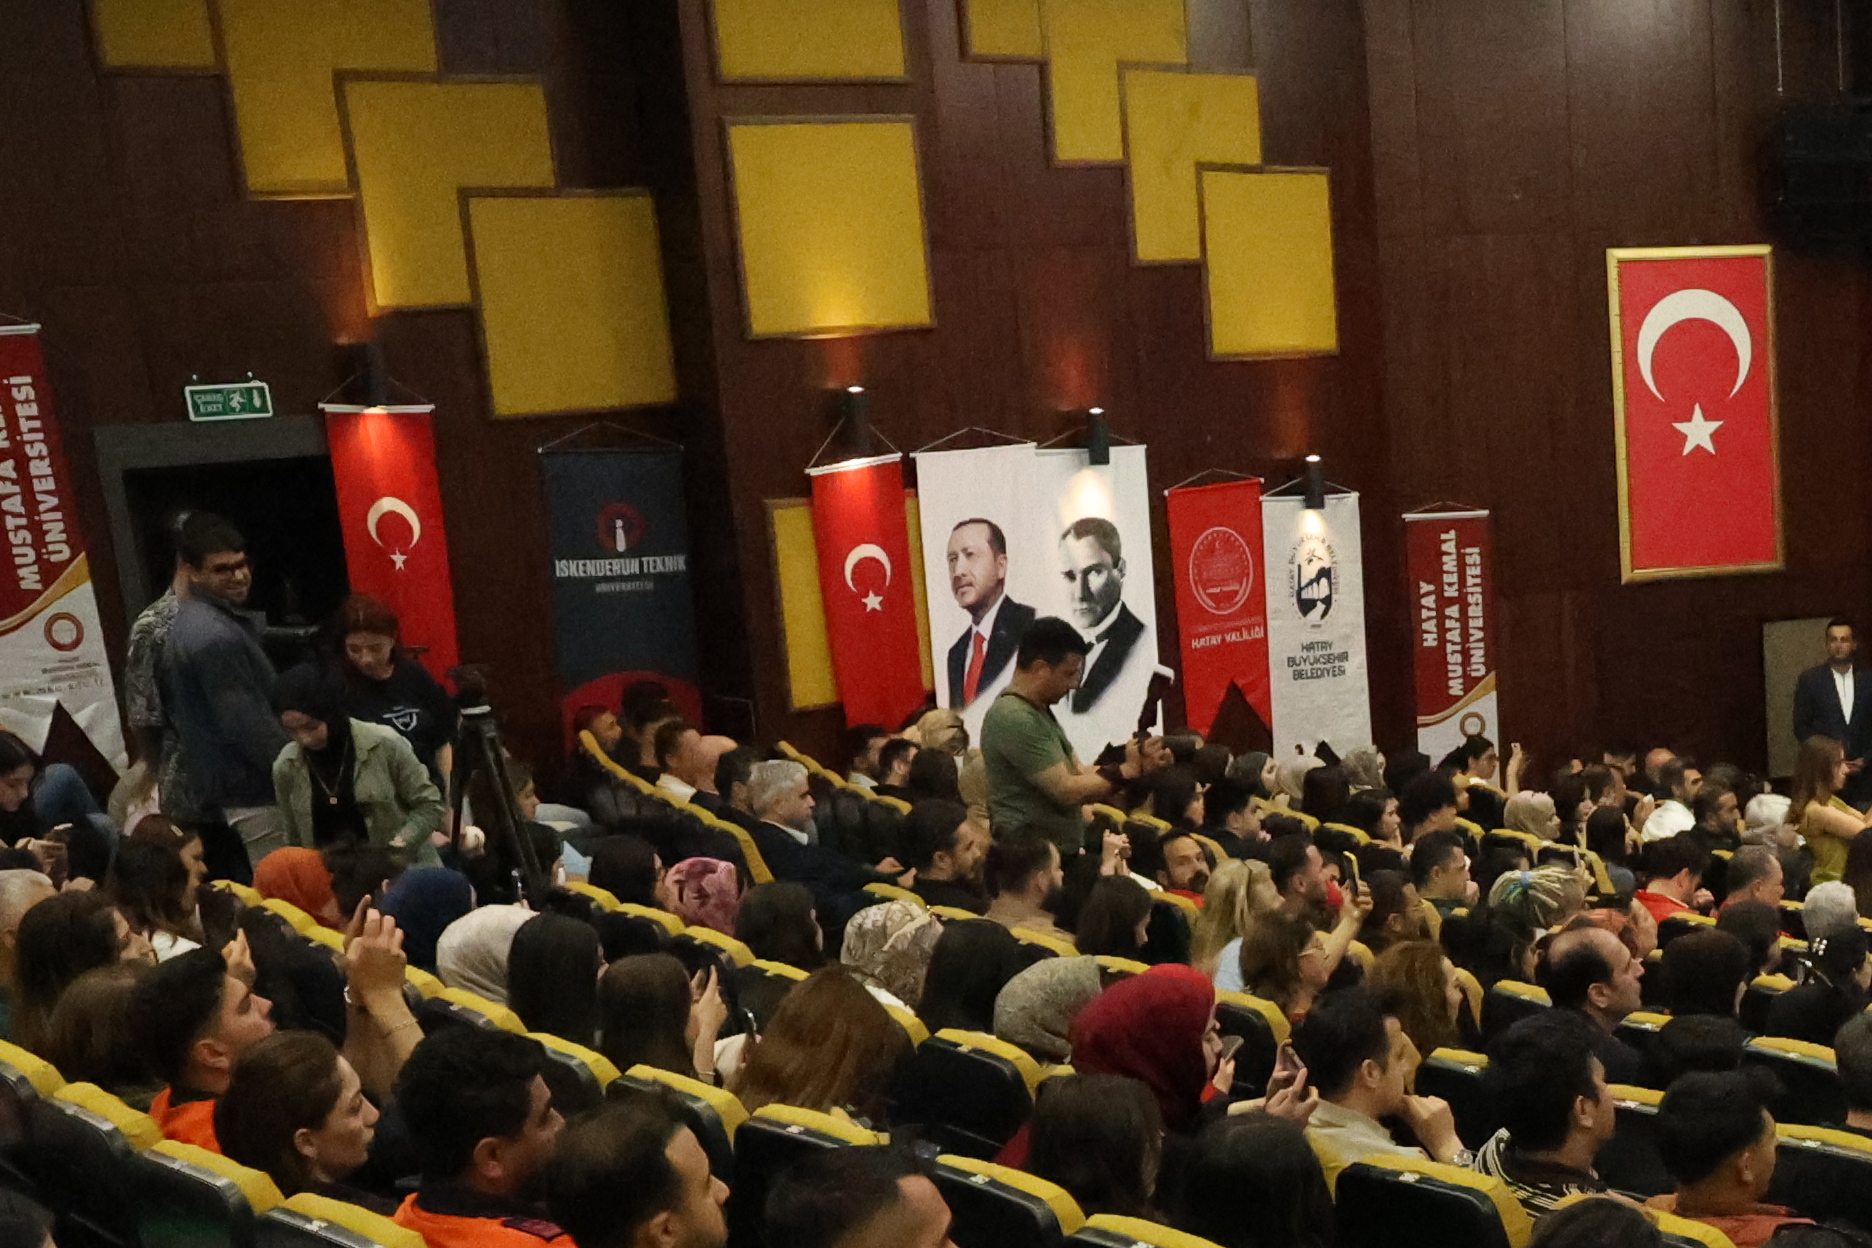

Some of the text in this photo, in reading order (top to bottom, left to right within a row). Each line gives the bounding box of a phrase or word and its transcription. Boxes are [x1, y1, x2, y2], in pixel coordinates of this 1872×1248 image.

[0, 458, 44, 591] MUSTAFA
[3, 375, 71, 563] ÜNİVERSİTESİ
[1191, 634, 1222, 650] HATAY
[1301, 641, 1334, 653] HATAY
[1419, 580, 1439, 647] HATAY
[1440, 528, 1465, 697] MUSTAFA KEMAL
[1460, 546, 1487, 678] ÜNİVERSİTESİ
